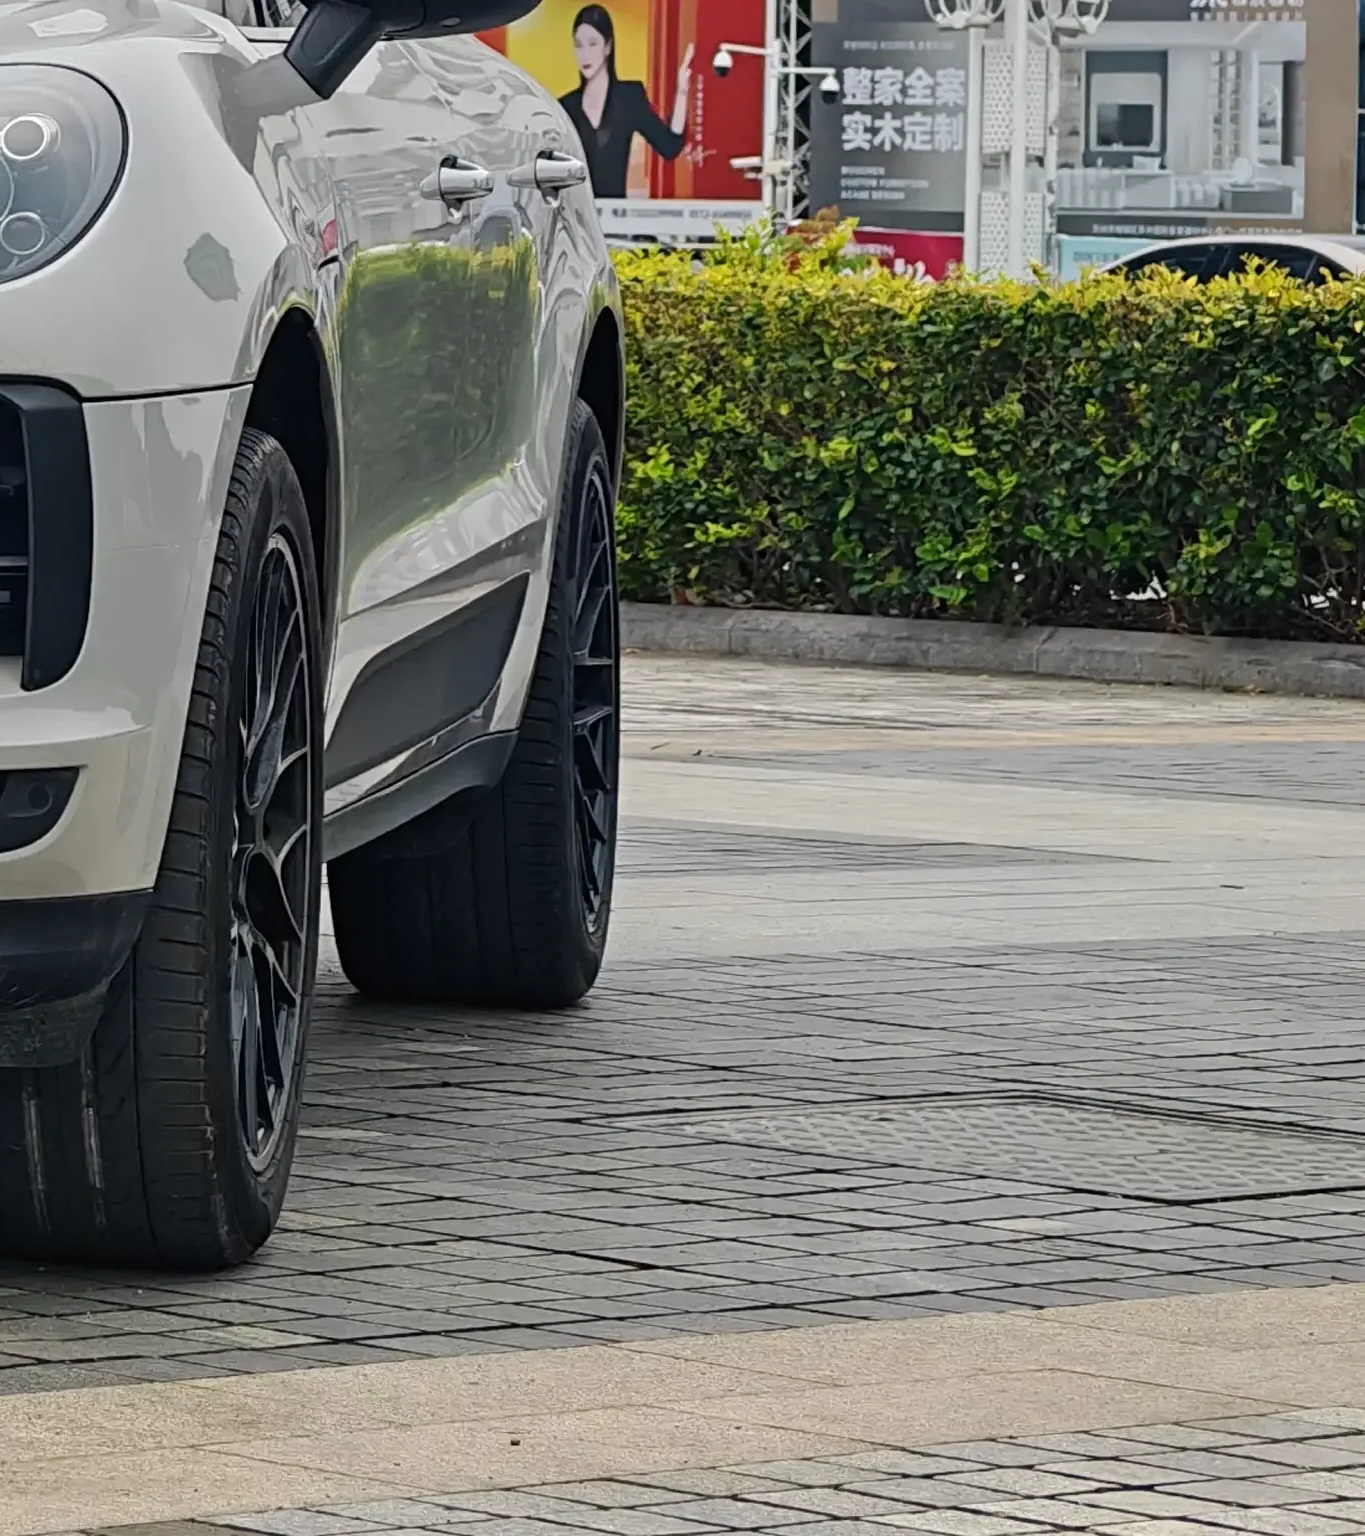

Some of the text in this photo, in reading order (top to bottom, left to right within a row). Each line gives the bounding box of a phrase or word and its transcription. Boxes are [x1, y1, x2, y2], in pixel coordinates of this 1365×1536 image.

[841, 66, 966, 107] 整家全案
[841, 111, 964, 153] 实木定制
